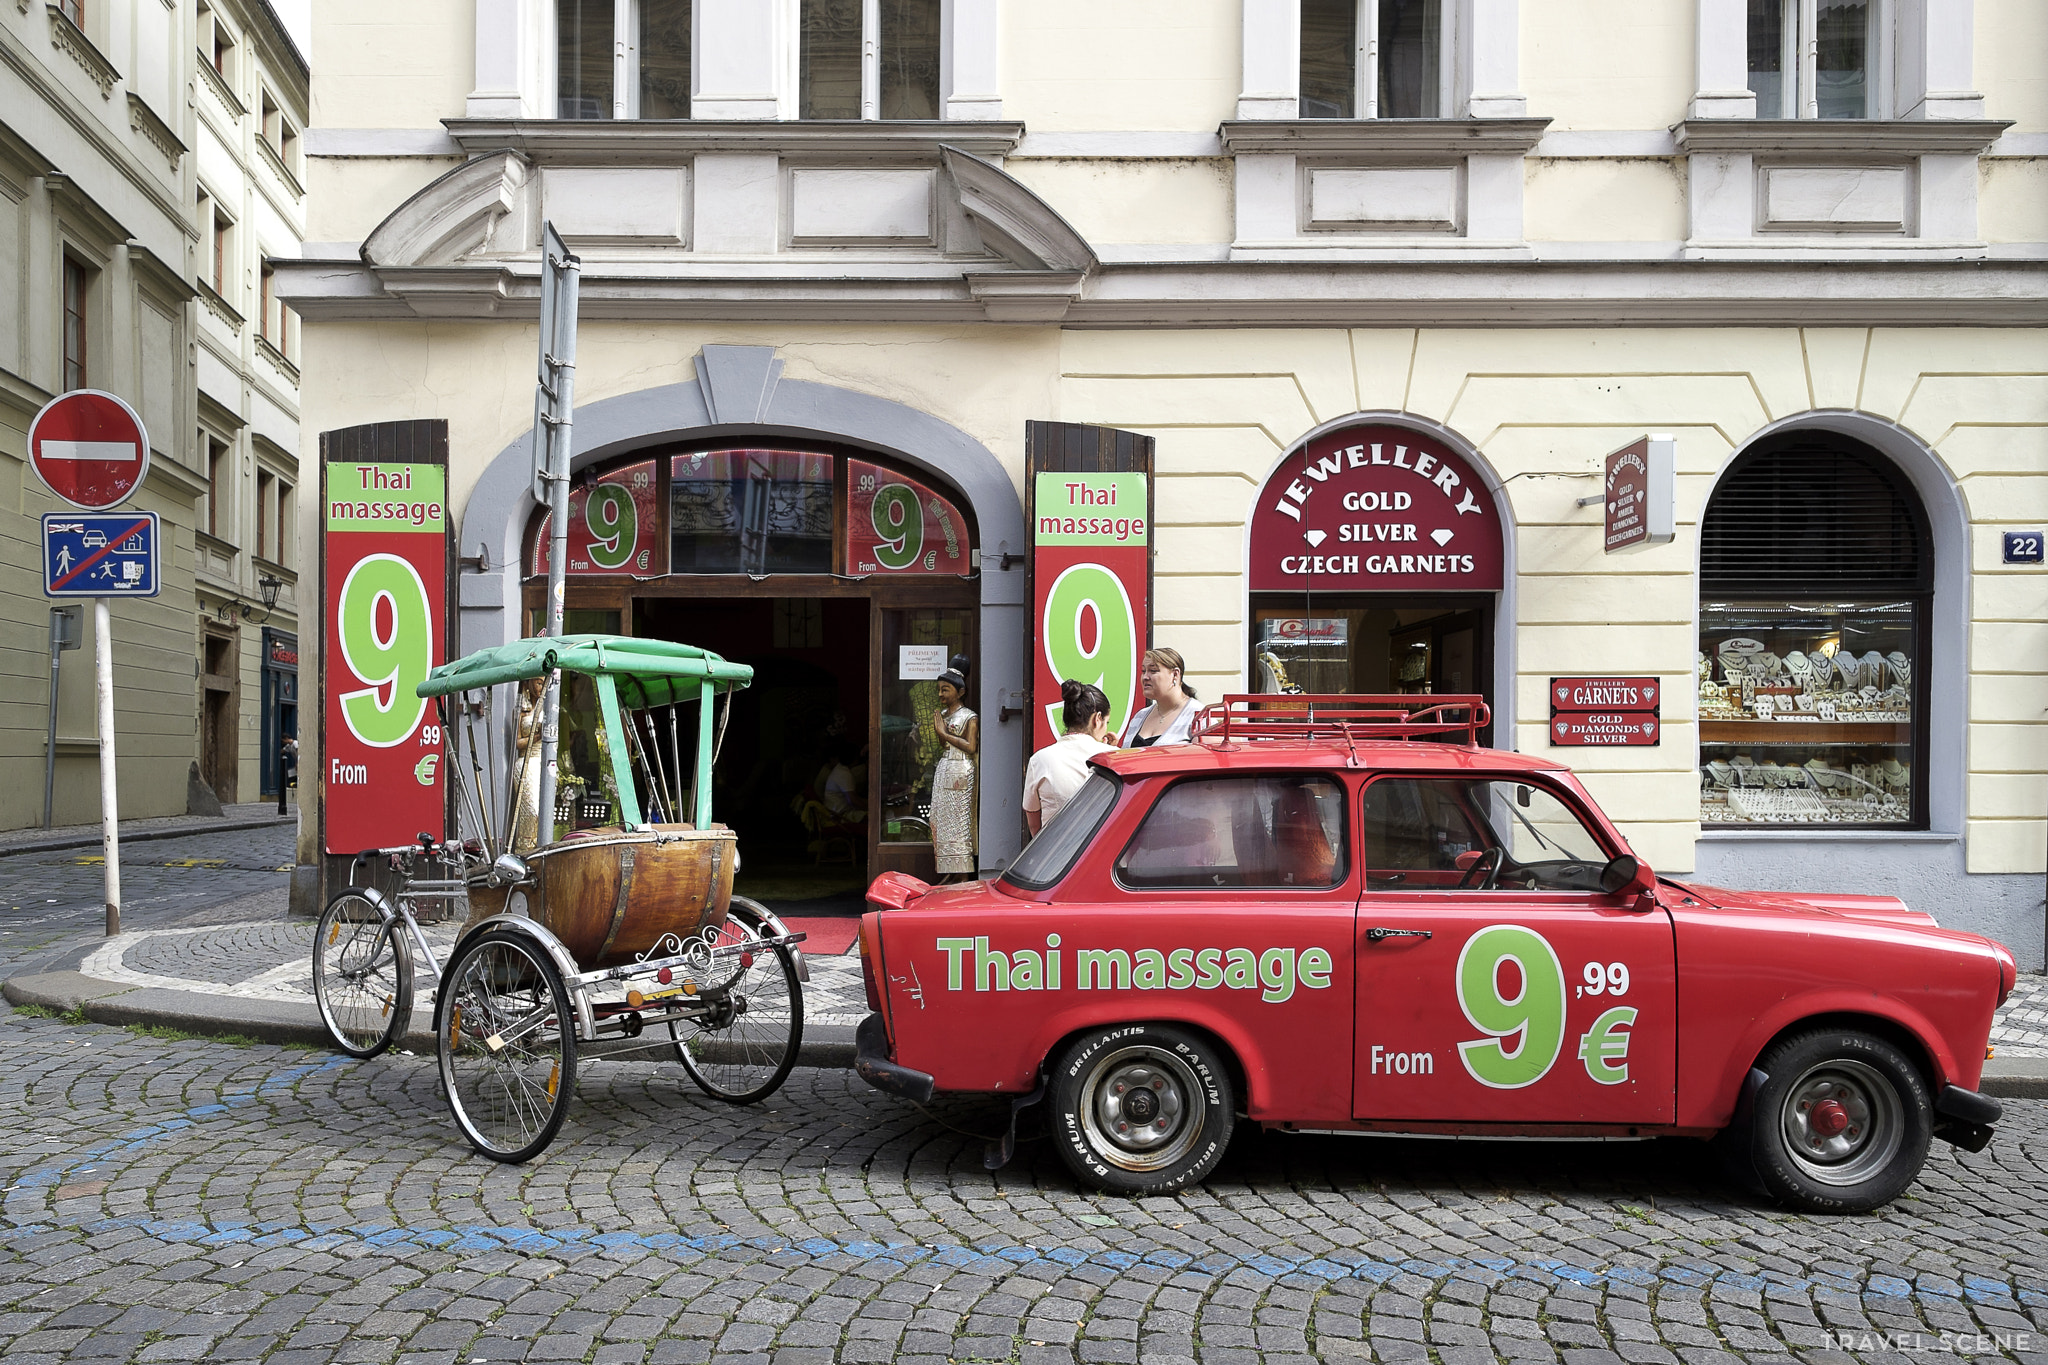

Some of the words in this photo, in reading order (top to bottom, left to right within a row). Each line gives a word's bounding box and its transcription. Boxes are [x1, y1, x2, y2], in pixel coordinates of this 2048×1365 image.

[356, 465, 412, 490] Thai
[1275, 443, 1482, 522] JEWELLERY
[1607, 454, 1646, 491] JEWELLERY
[1065, 482, 1117, 506] Thai
[1342, 492, 1412, 511] GOLD
[1618, 495, 1634, 508] SILVER
[1619, 484, 1633, 496] GOLD
[331, 501, 441, 526] massage
[586, 483, 638, 569] 9
[632, 472, 649, 490] ,99
[857, 475, 875, 493] ,99
[871, 483, 924, 570] 9
[1612, 515, 1638, 531] DIAMONDS
[1039, 517, 1144, 541] massage
[1338, 524, 1418, 542] SILVER
[2012, 537, 2037, 555] 22
[570, 560, 589, 570] From
[858, 561, 876, 572] From
[1281, 555, 1359, 574] CZECH
[1365, 555, 1475, 574] GARNETS
[338, 552, 433, 748] 9
[419, 725, 440, 746] ,99
[1043, 562, 1137, 744] 9
[1573, 687, 1638, 705] GARNETS
[1571, 725, 1640, 733] DIAMONDS
[1588, 715, 1623, 723] GOLD
[1583, 735, 1627, 743] SILVER
[331, 758, 367, 784] From
[413, 753, 440, 786] €
[936, 933, 1062, 991] Thai
[1077, 946, 1333, 1003] massage
[1455, 924, 1567, 1089] 9
[1576, 962, 1630, 999] ,99
[1069, 1026, 1145, 1077] BRILLANTIS
[1577, 1006, 1639, 1085] €
[1371, 1045, 1434, 1075] From
[1175, 1042, 1220, 1105] BARUM
[1065, 1112, 1109, 1177] BARUM
